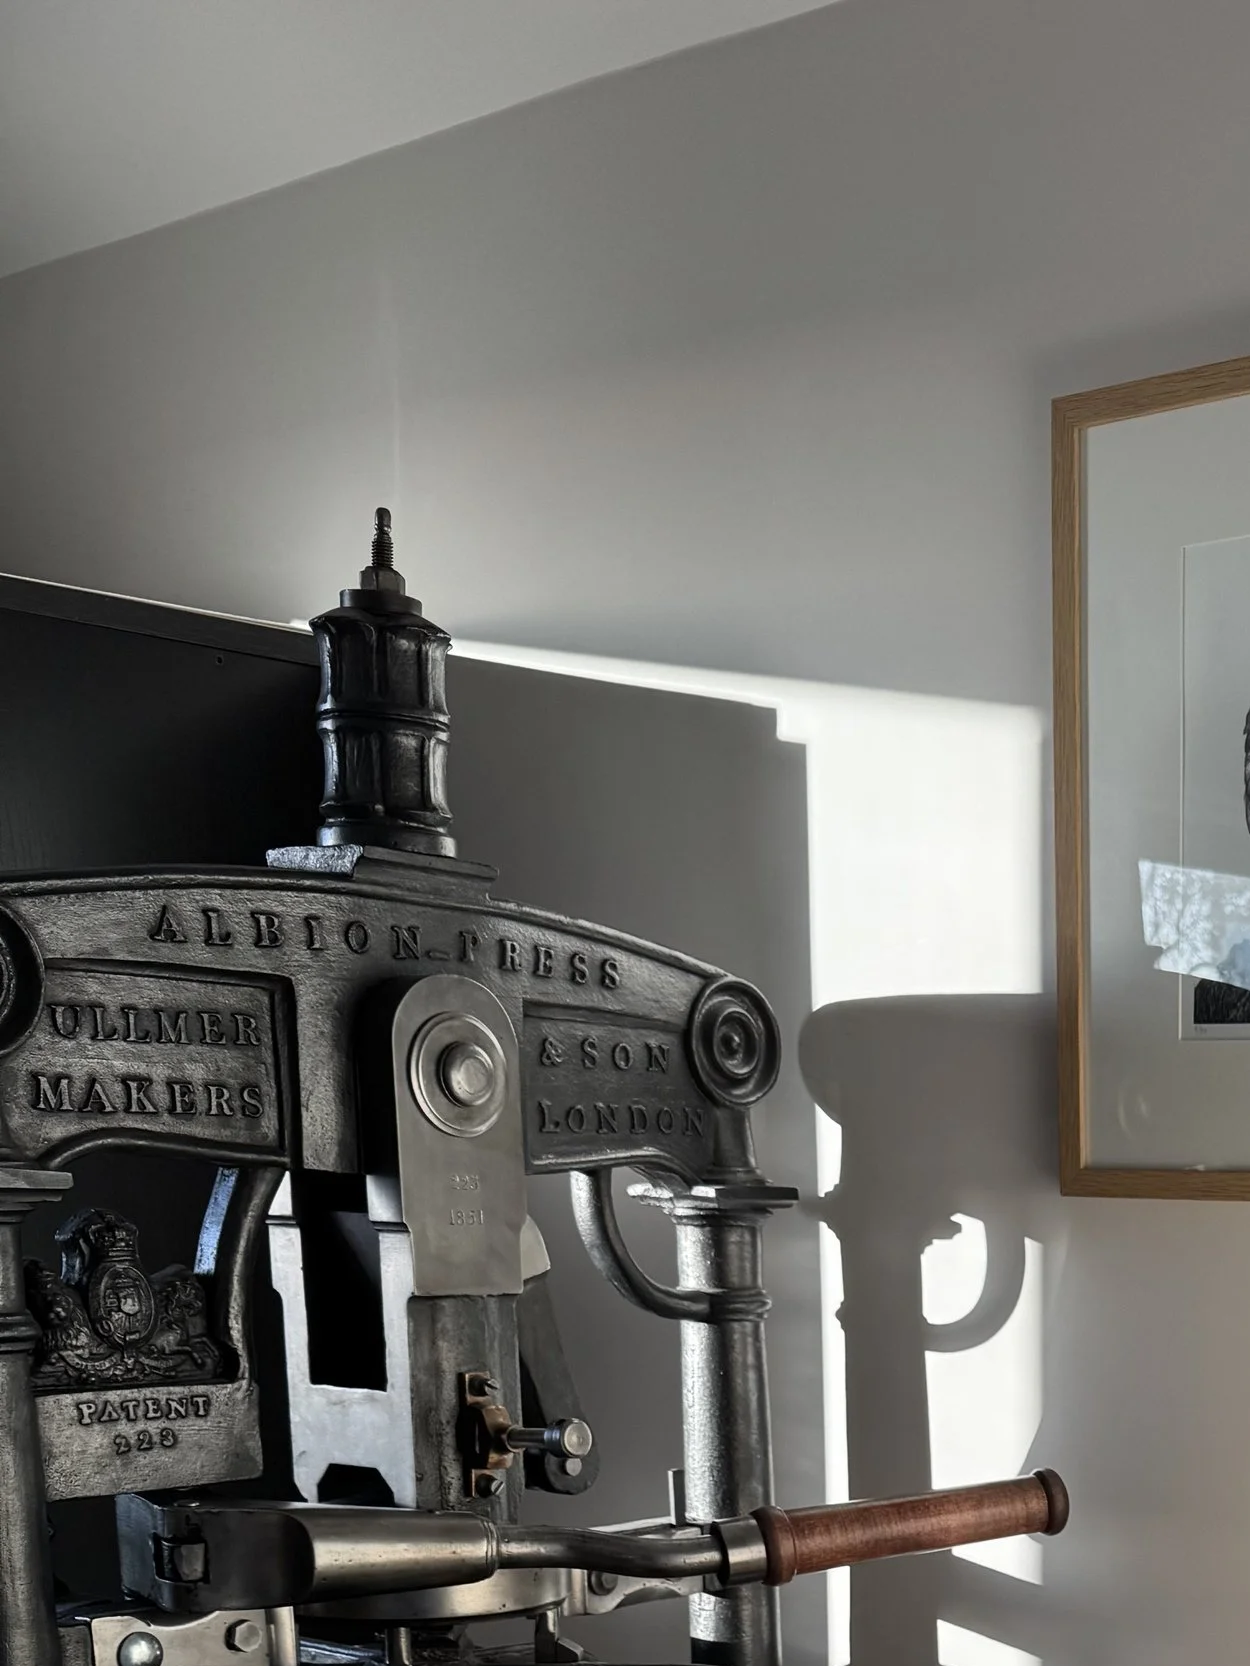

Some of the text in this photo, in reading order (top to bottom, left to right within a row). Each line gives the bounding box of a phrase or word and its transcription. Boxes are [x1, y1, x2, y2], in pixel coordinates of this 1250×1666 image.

[48, 1003, 262, 1046] ULLMER
[540, 1034, 670, 1073] & SON
[31, 1073, 264, 1118] MAKERS
[538, 1099, 705, 1135] LONDON
[449, 1208, 484, 1226] 1851
[78, 1394, 210, 1425] PATENT
[113, 1427, 176, 1455] 223
